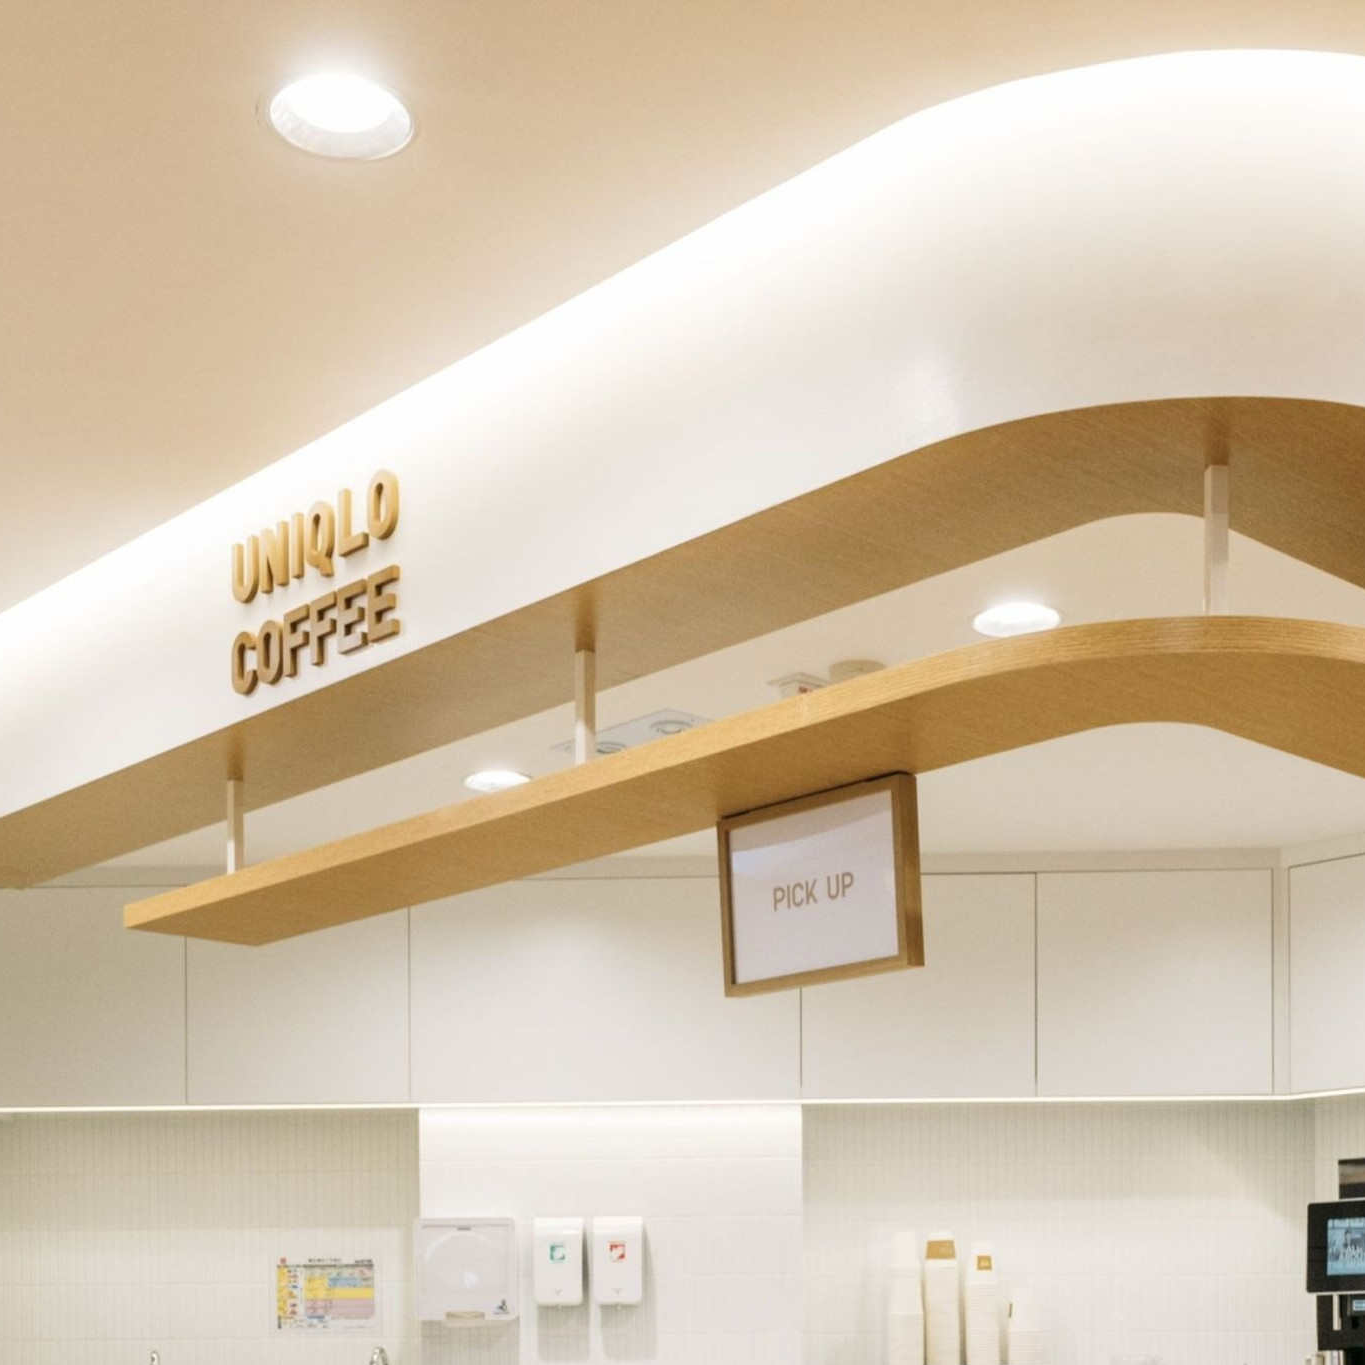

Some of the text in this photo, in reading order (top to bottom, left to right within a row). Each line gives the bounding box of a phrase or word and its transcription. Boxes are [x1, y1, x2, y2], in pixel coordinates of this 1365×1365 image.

[231, 469, 400, 604] UNIQLO
[231, 564, 400, 696] COFFEE
[773, 872, 854, 912] PICK UP
